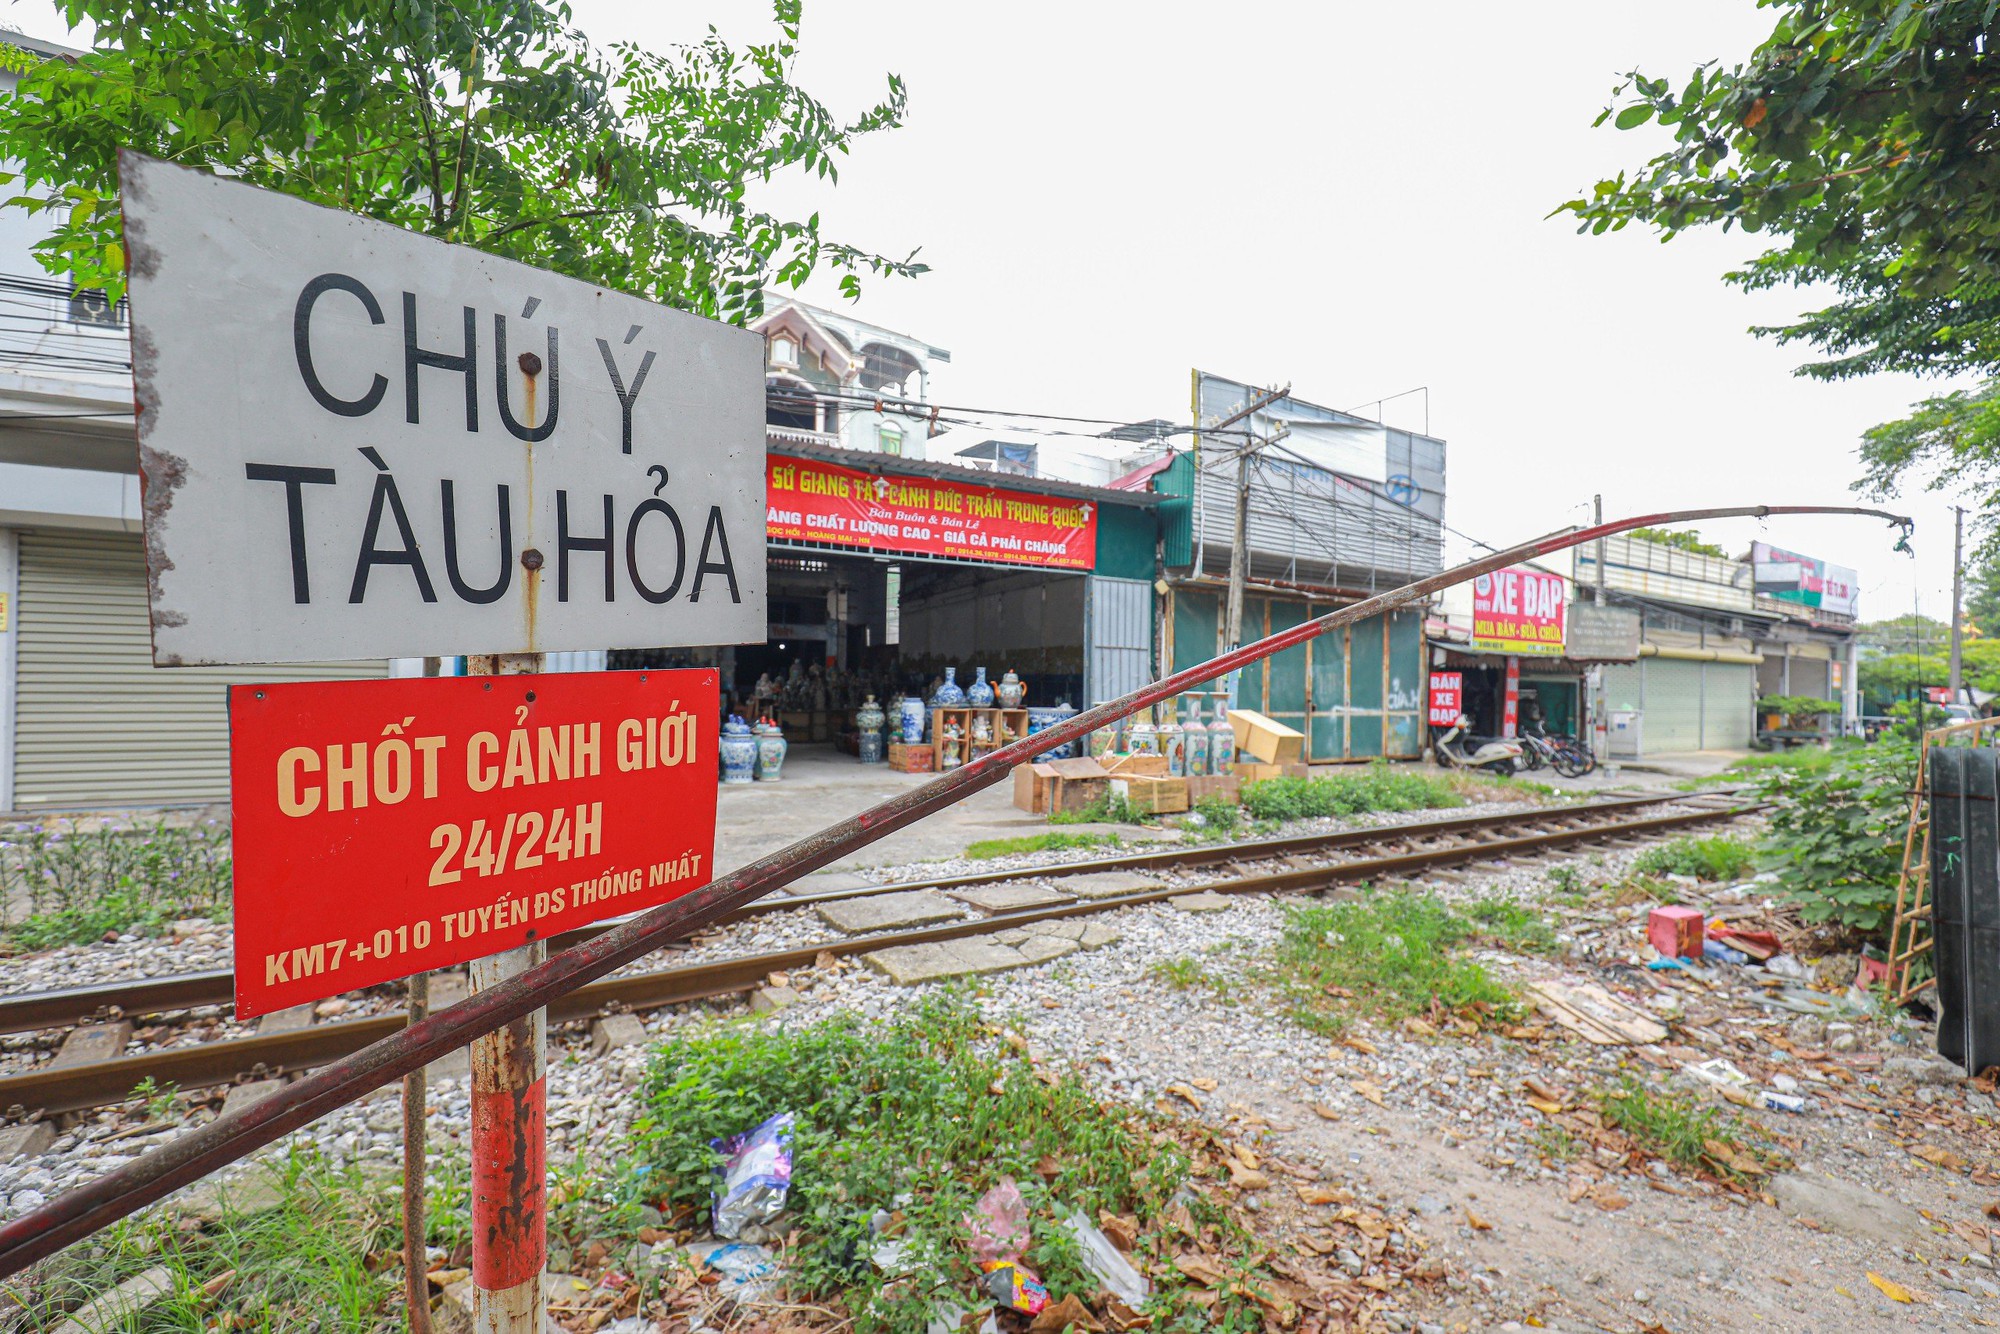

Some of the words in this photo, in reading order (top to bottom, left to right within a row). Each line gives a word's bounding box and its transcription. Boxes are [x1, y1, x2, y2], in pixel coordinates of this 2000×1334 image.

[293, 272, 559, 443] CHÚ
[594, 324, 658, 455] Ý
[772, 464, 796, 491] SỨ
[800, 469, 849, 499] GIANG
[933, 487, 963, 514] ĐỨC
[966, 491, 1003, 519] TRẤN
[1005, 499, 1049, 525] TRUNG
[868, 507, 893, 519] Bán
[895, 510, 926, 523] Buôn
[928, 514, 938, 524] &
[941, 516, 963, 527] Bán
[244, 446, 514, 605] TÀU
[555, 464, 742, 605] HỎA
[766, 506, 802, 525] ÀNG
[805, 512, 847, 531] CHẤT
[850, 518, 900, 538] LƯỢNG
[902, 525, 931, 541] CAO
[943, 529, 967, 545] GIÁ
[970, 532, 989, 547] CẢ
[991, 535, 1022, 551] PHẢI
[1024, 539, 1067, 555] CHĂNG
[1491, 570, 1518, 616] XE
[1523, 574, 1564, 625] ĐẠP
[1475, 619, 1496, 636] MUA
[1430, 673, 1460, 690] BÁN
[1434, 692, 1455, 706] XE
[1430, 707, 1460, 725] ĐẠP
[276, 715, 447, 819] CHỐT
[466, 705, 601, 794] CẢNH
[616, 699, 698, 774] GIỚI
[428, 801, 603, 888] 24/24H
[264, 919, 432, 988] KM7+010
[441, 891, 530, 943] TUYẾN
[534, 887, 566, 921] ĐS
[570, 865, 643, 909] THỐNG
[648, 848, 703, 888] NHẤT
